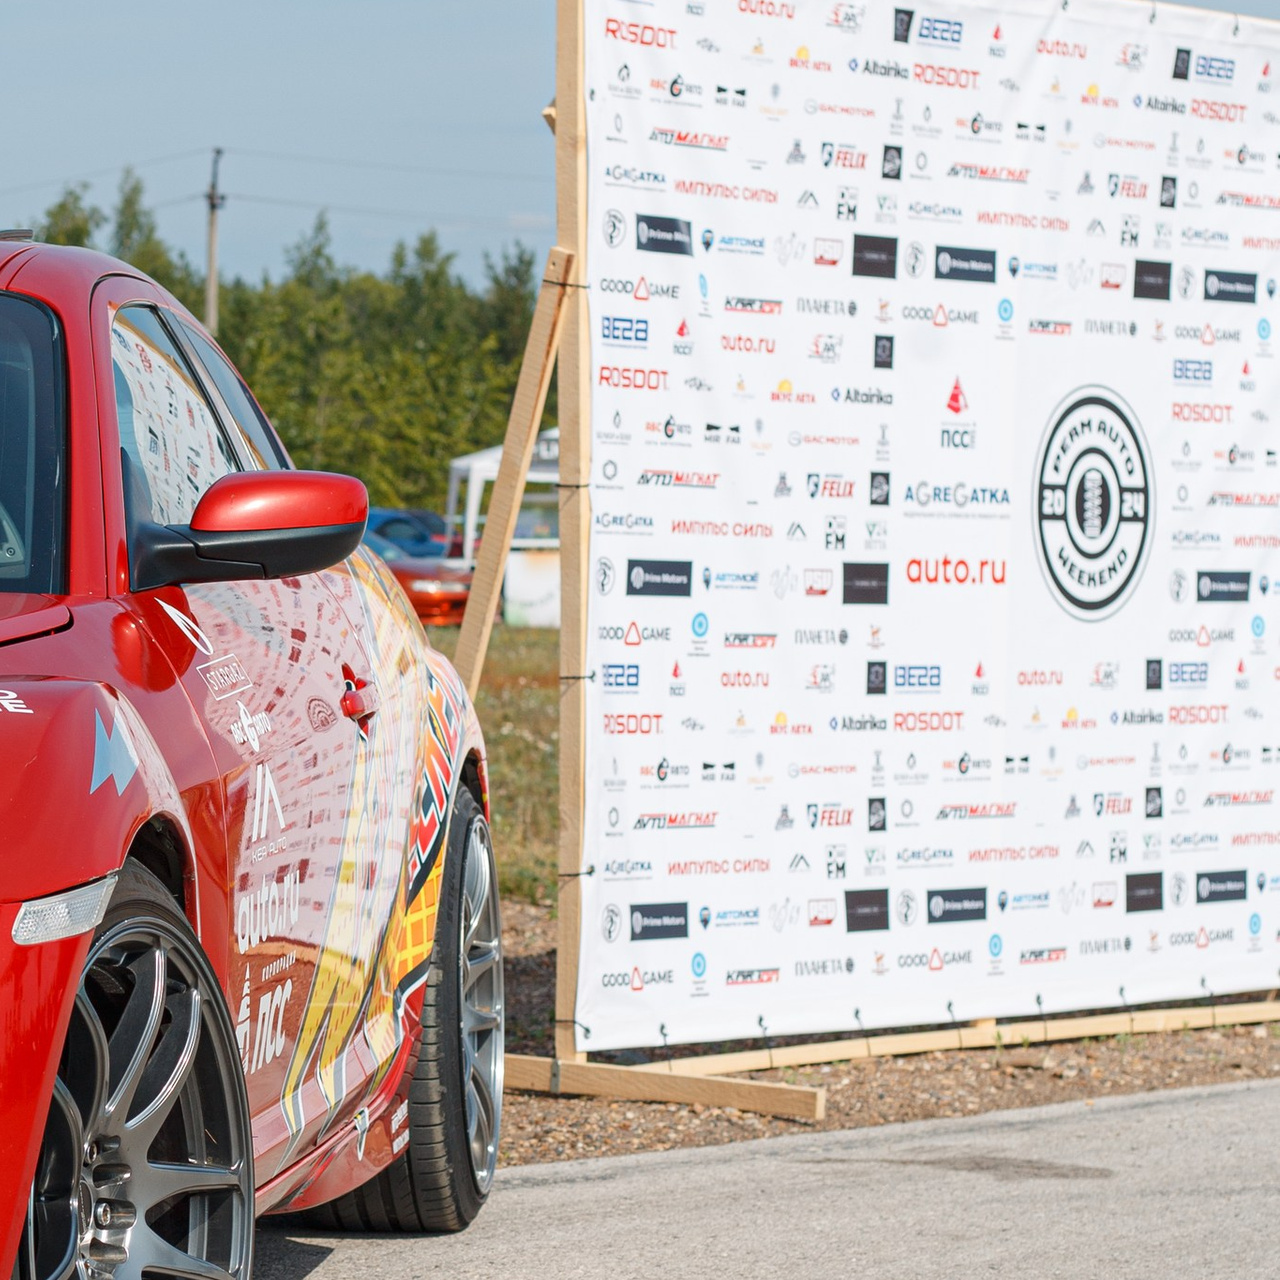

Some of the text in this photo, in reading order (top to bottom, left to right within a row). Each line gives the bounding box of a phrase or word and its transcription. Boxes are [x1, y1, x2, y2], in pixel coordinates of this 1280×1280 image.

[605, 19, 677, 49] ROSDOT
[1037, 38, 1087, 59] auto.ru
[914, 64, 980, 90] ROSDOT
[1191, 98, 1247, 122] ROSDOT
[835, 149, 868, 169] FELIX
[1121, 180, 1149, 199] FELIX
[721, 334, 775, 354] auto.ru
[599, 366, 668, 391] ROSDOT
[844, 387, 893, 405] Altairika
[1173, 402, 1233, 423] ROSDOT
[1054, 419, 1135, 476] PERM AUTO
[821, 480, 854, 499] FELIX
[905, 481, 1010, 508] AGREGATKA
[1042, 488, 1066, 516] 20
[1122, 492, 1145, 518] 24
[673, 520, 773, 538] ИМПУЛЬС СИЛЫ
[906, 555, 1007, 585] auto.ru
[1058, 546, 1128, 588] WEEKEND
[642, 627, 671, 641] GAME
[206, 662, 245, 691] STARGAZ
[721, 671, 769, 688] auto.ru
[1018, 669, 1063, 685] auto.ru
[841, 715, 887, 731] Altairika
[894, 712, 965, 732] ROSDOT
[1169, 705, 1229, 725] ROSDOT
[1106, 797, 1132, 815] FELIX
[820, 809, 854, 827] FELIX
[969, 845, 1060, 862] ИМПУЛЬС СИЛЫ
[668, 858, 771, 876] ИМПУЛЬС СИЛЫ
[238, 870, 299, 955] auto.ru
[1170, 928, 1235, 946] GOOD GAME
[898, 950, 972, 968] GOOD GAME
[602, 970, 674, 987] GOOD GAME
